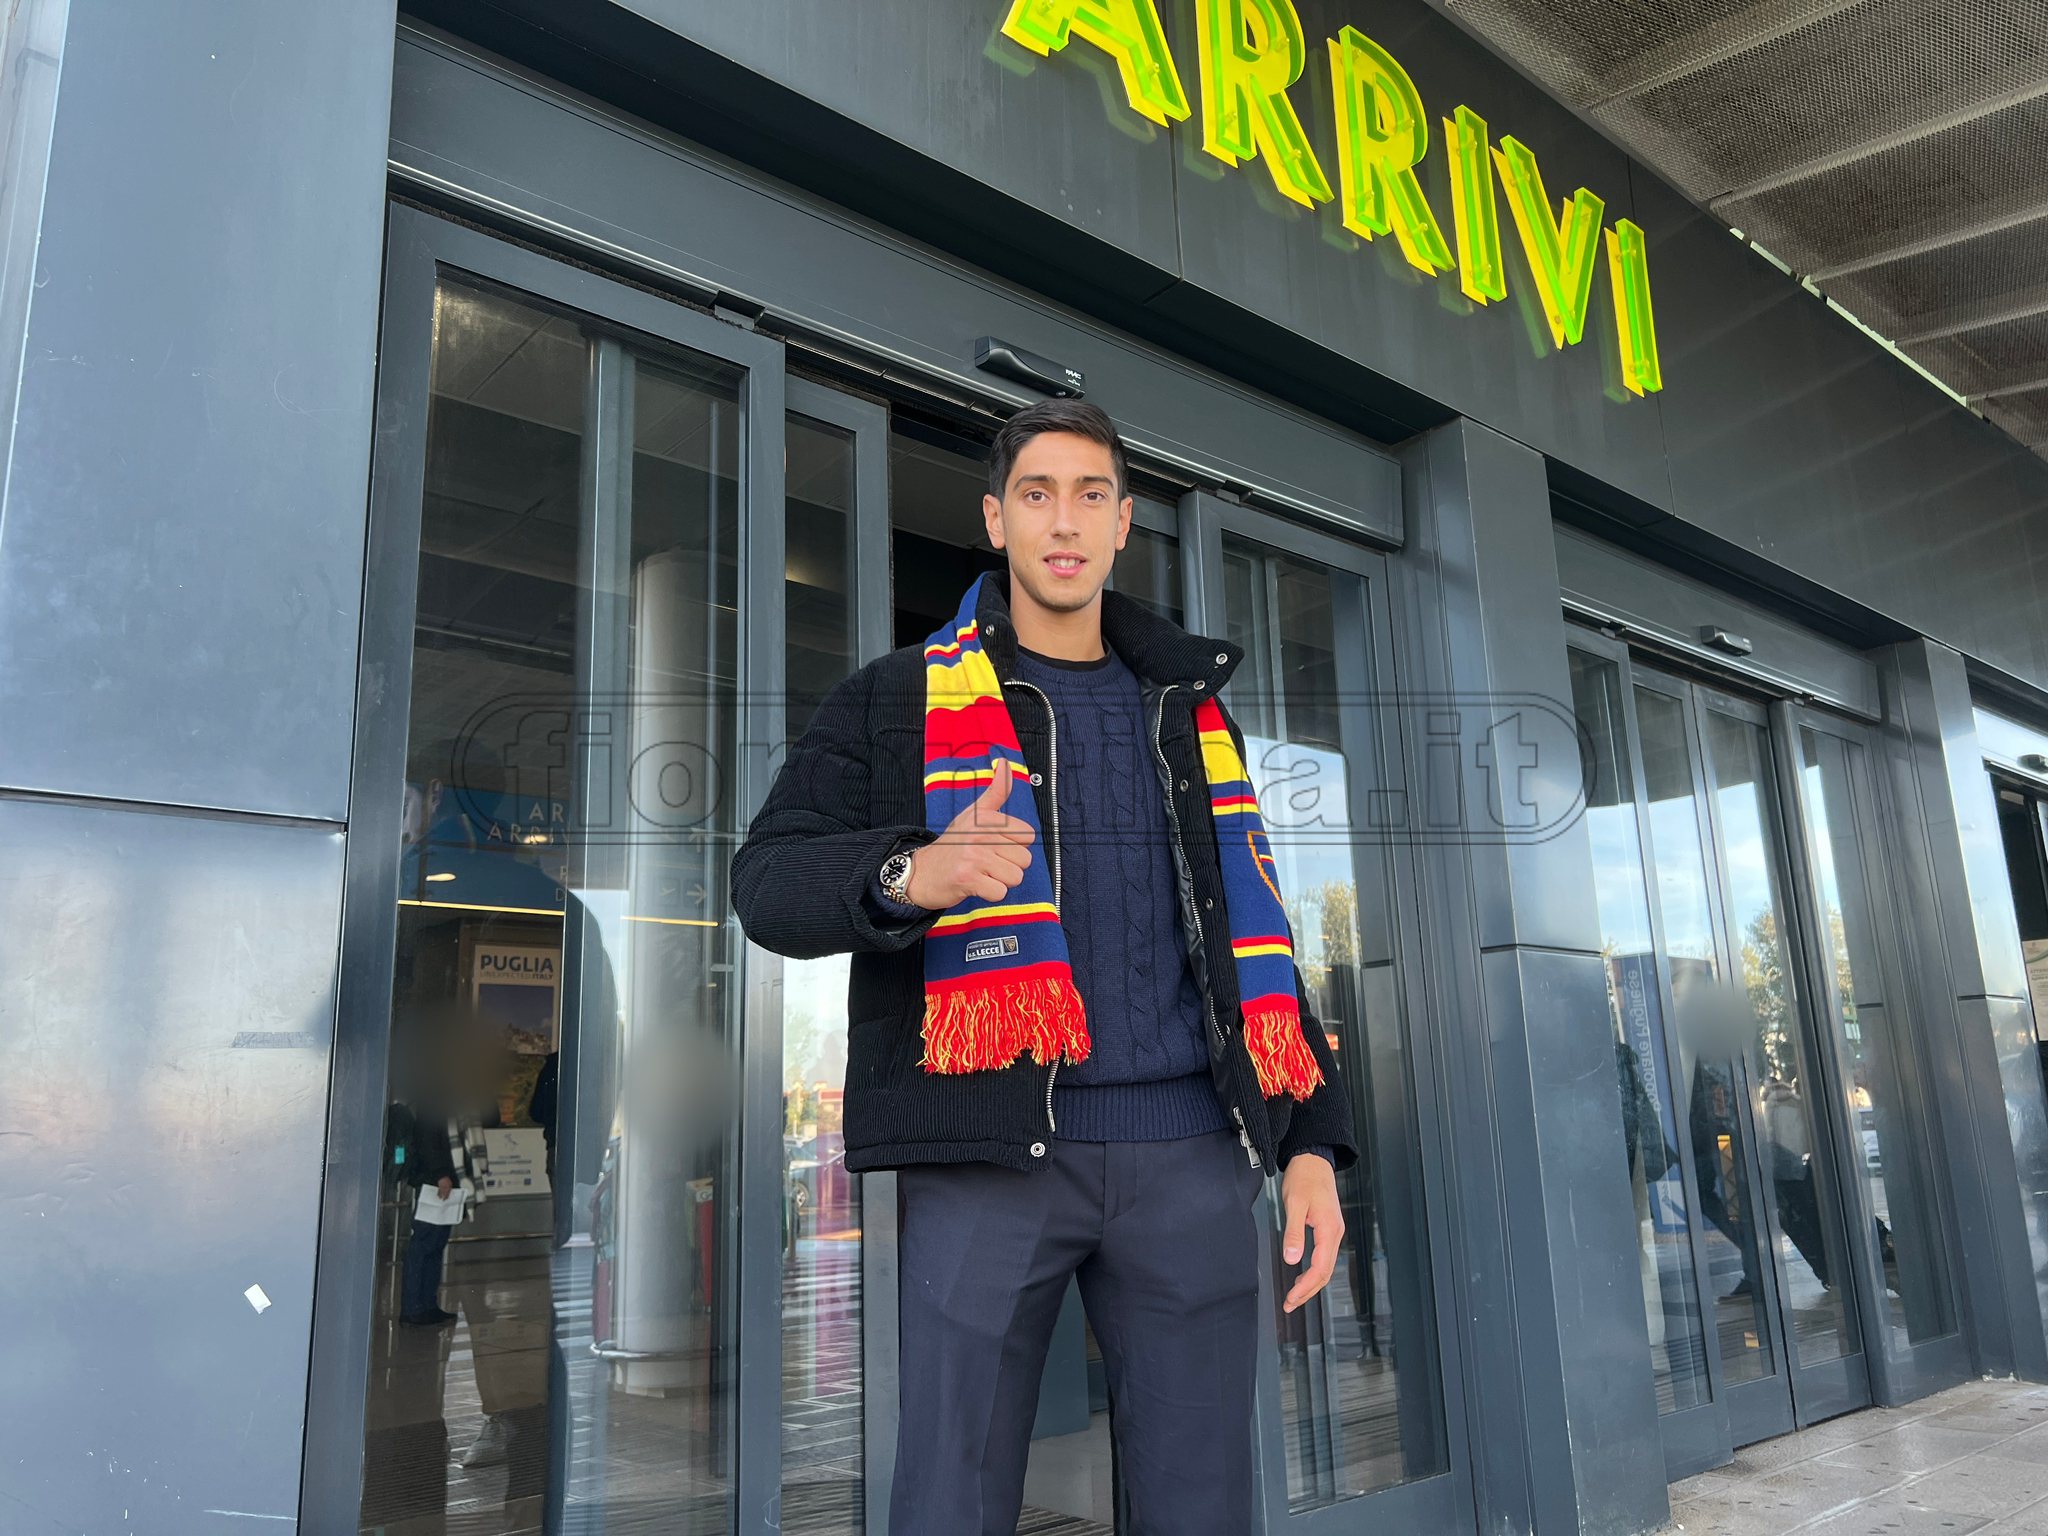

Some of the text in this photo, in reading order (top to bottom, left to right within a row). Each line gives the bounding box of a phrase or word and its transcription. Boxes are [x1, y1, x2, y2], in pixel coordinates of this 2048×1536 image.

[1000, 0, 1662, 397] ARRIVI
[976, 946, 1000, 956] LECCE
[480, 954, 554, 973] PUGLIA
